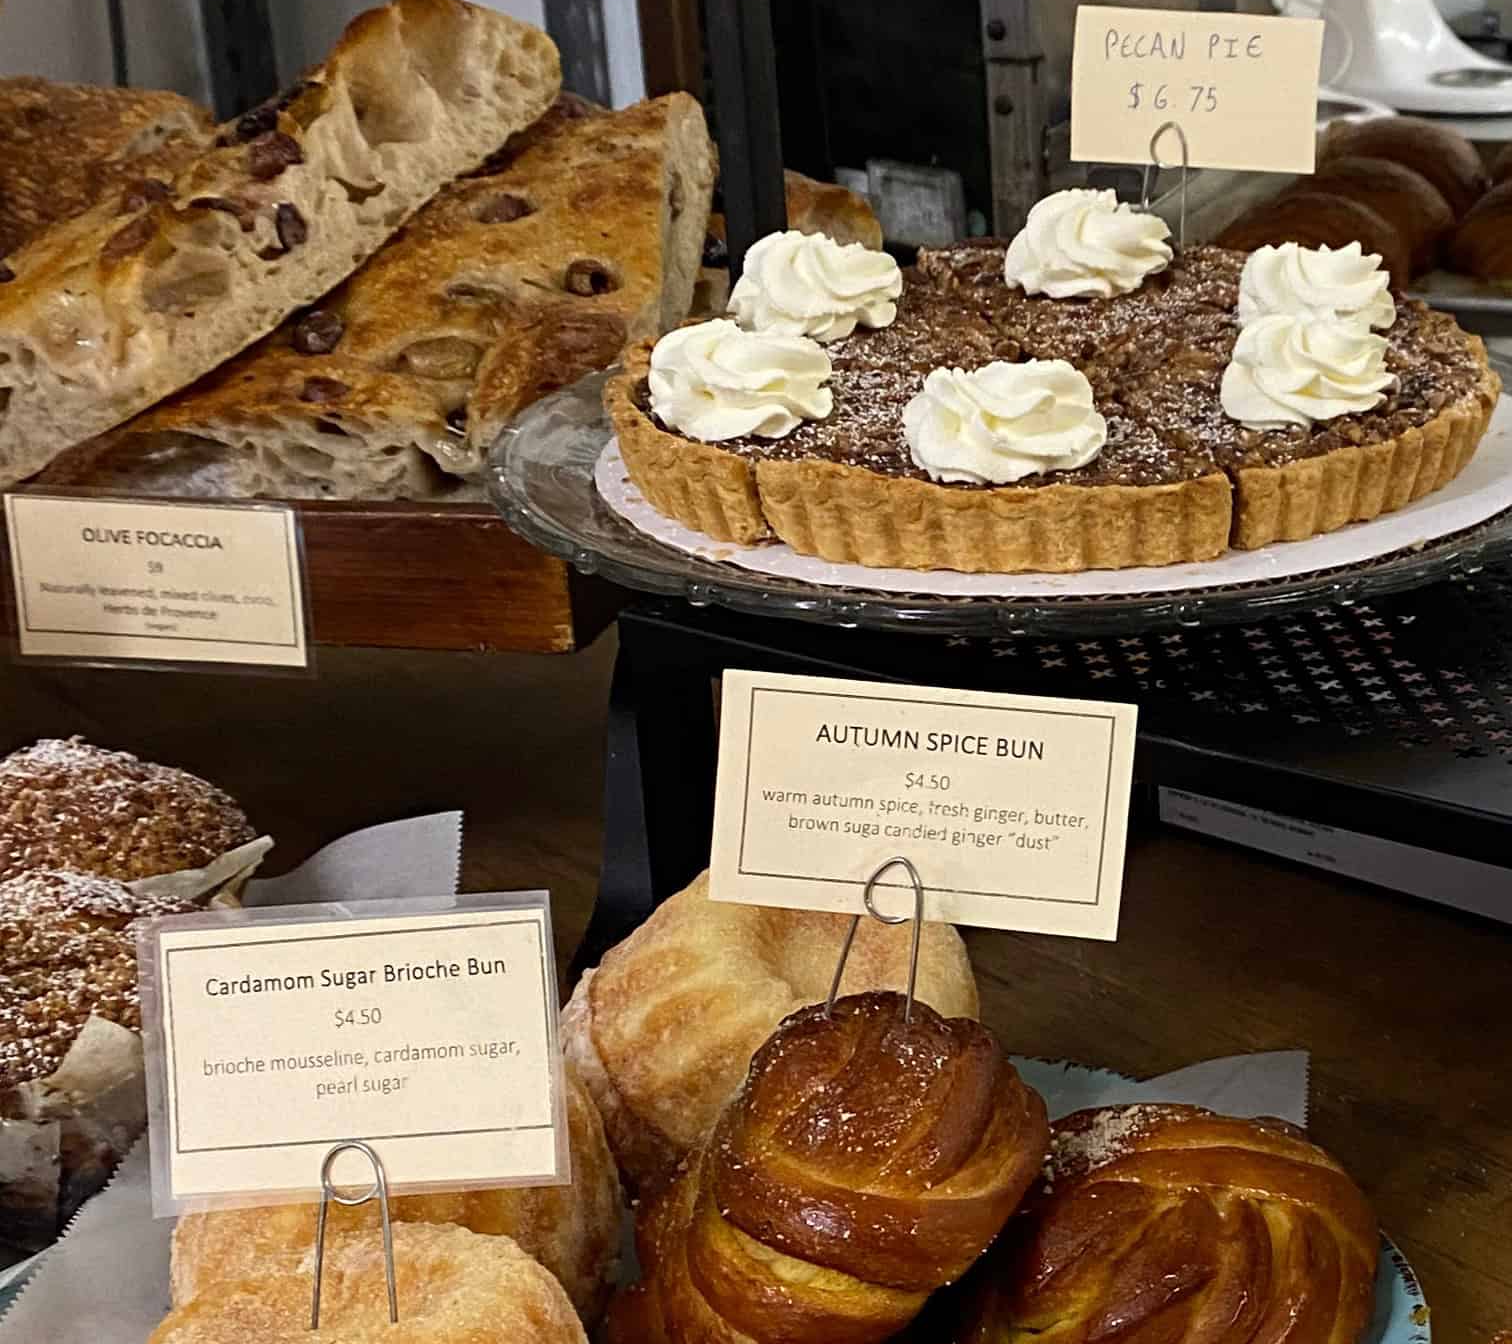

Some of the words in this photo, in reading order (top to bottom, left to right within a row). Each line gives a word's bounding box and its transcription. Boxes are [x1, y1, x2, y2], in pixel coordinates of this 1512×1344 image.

[1104, 29, 1186, 60] PECAN
[1208, 33, 1264, 58] PIE
[82, 528, 130, 545] OLIVE
[135, 530, 224, 550] FOCACCIA
[816, 723, 920, 751] AUTUMN
[926, 732, 989, 757] SPICE
[996, 738, 1045, 761] BUN
[904, 771, 951, 792] $4.50
[762, 788, 807, 805] warm
[812, 792, 875, 810] autumn
[879, 798, 924, 816] spice,
[928, 799, 969, 818] fresh
[974, 806, 1030, 826] ginger,
[1034, 809, 1090, 830] butter,
[788, 814, 839, 833] brown
[884, 822, 947, 842] candied
[951, 829, 1005, 848] ginger
[205, 972, 315, 998] Cardamom
[320, 968, 376, 990] Sugar
[384, 959, 460, 983] Brioche
[468, 957, 506, 977] Bun
[334, 1007, 382, 1028] $4.50
[203, 1056, 266, 1077] brioche
[270, 1049, 370, 1071] mousseline,
[374, 1043, 465, 1065] cardamom
[469, 1040, 521, 1060] sugar,
[316, 1077, 359, 1099] pearl
[363, 1075, 410, 1095] sugar
